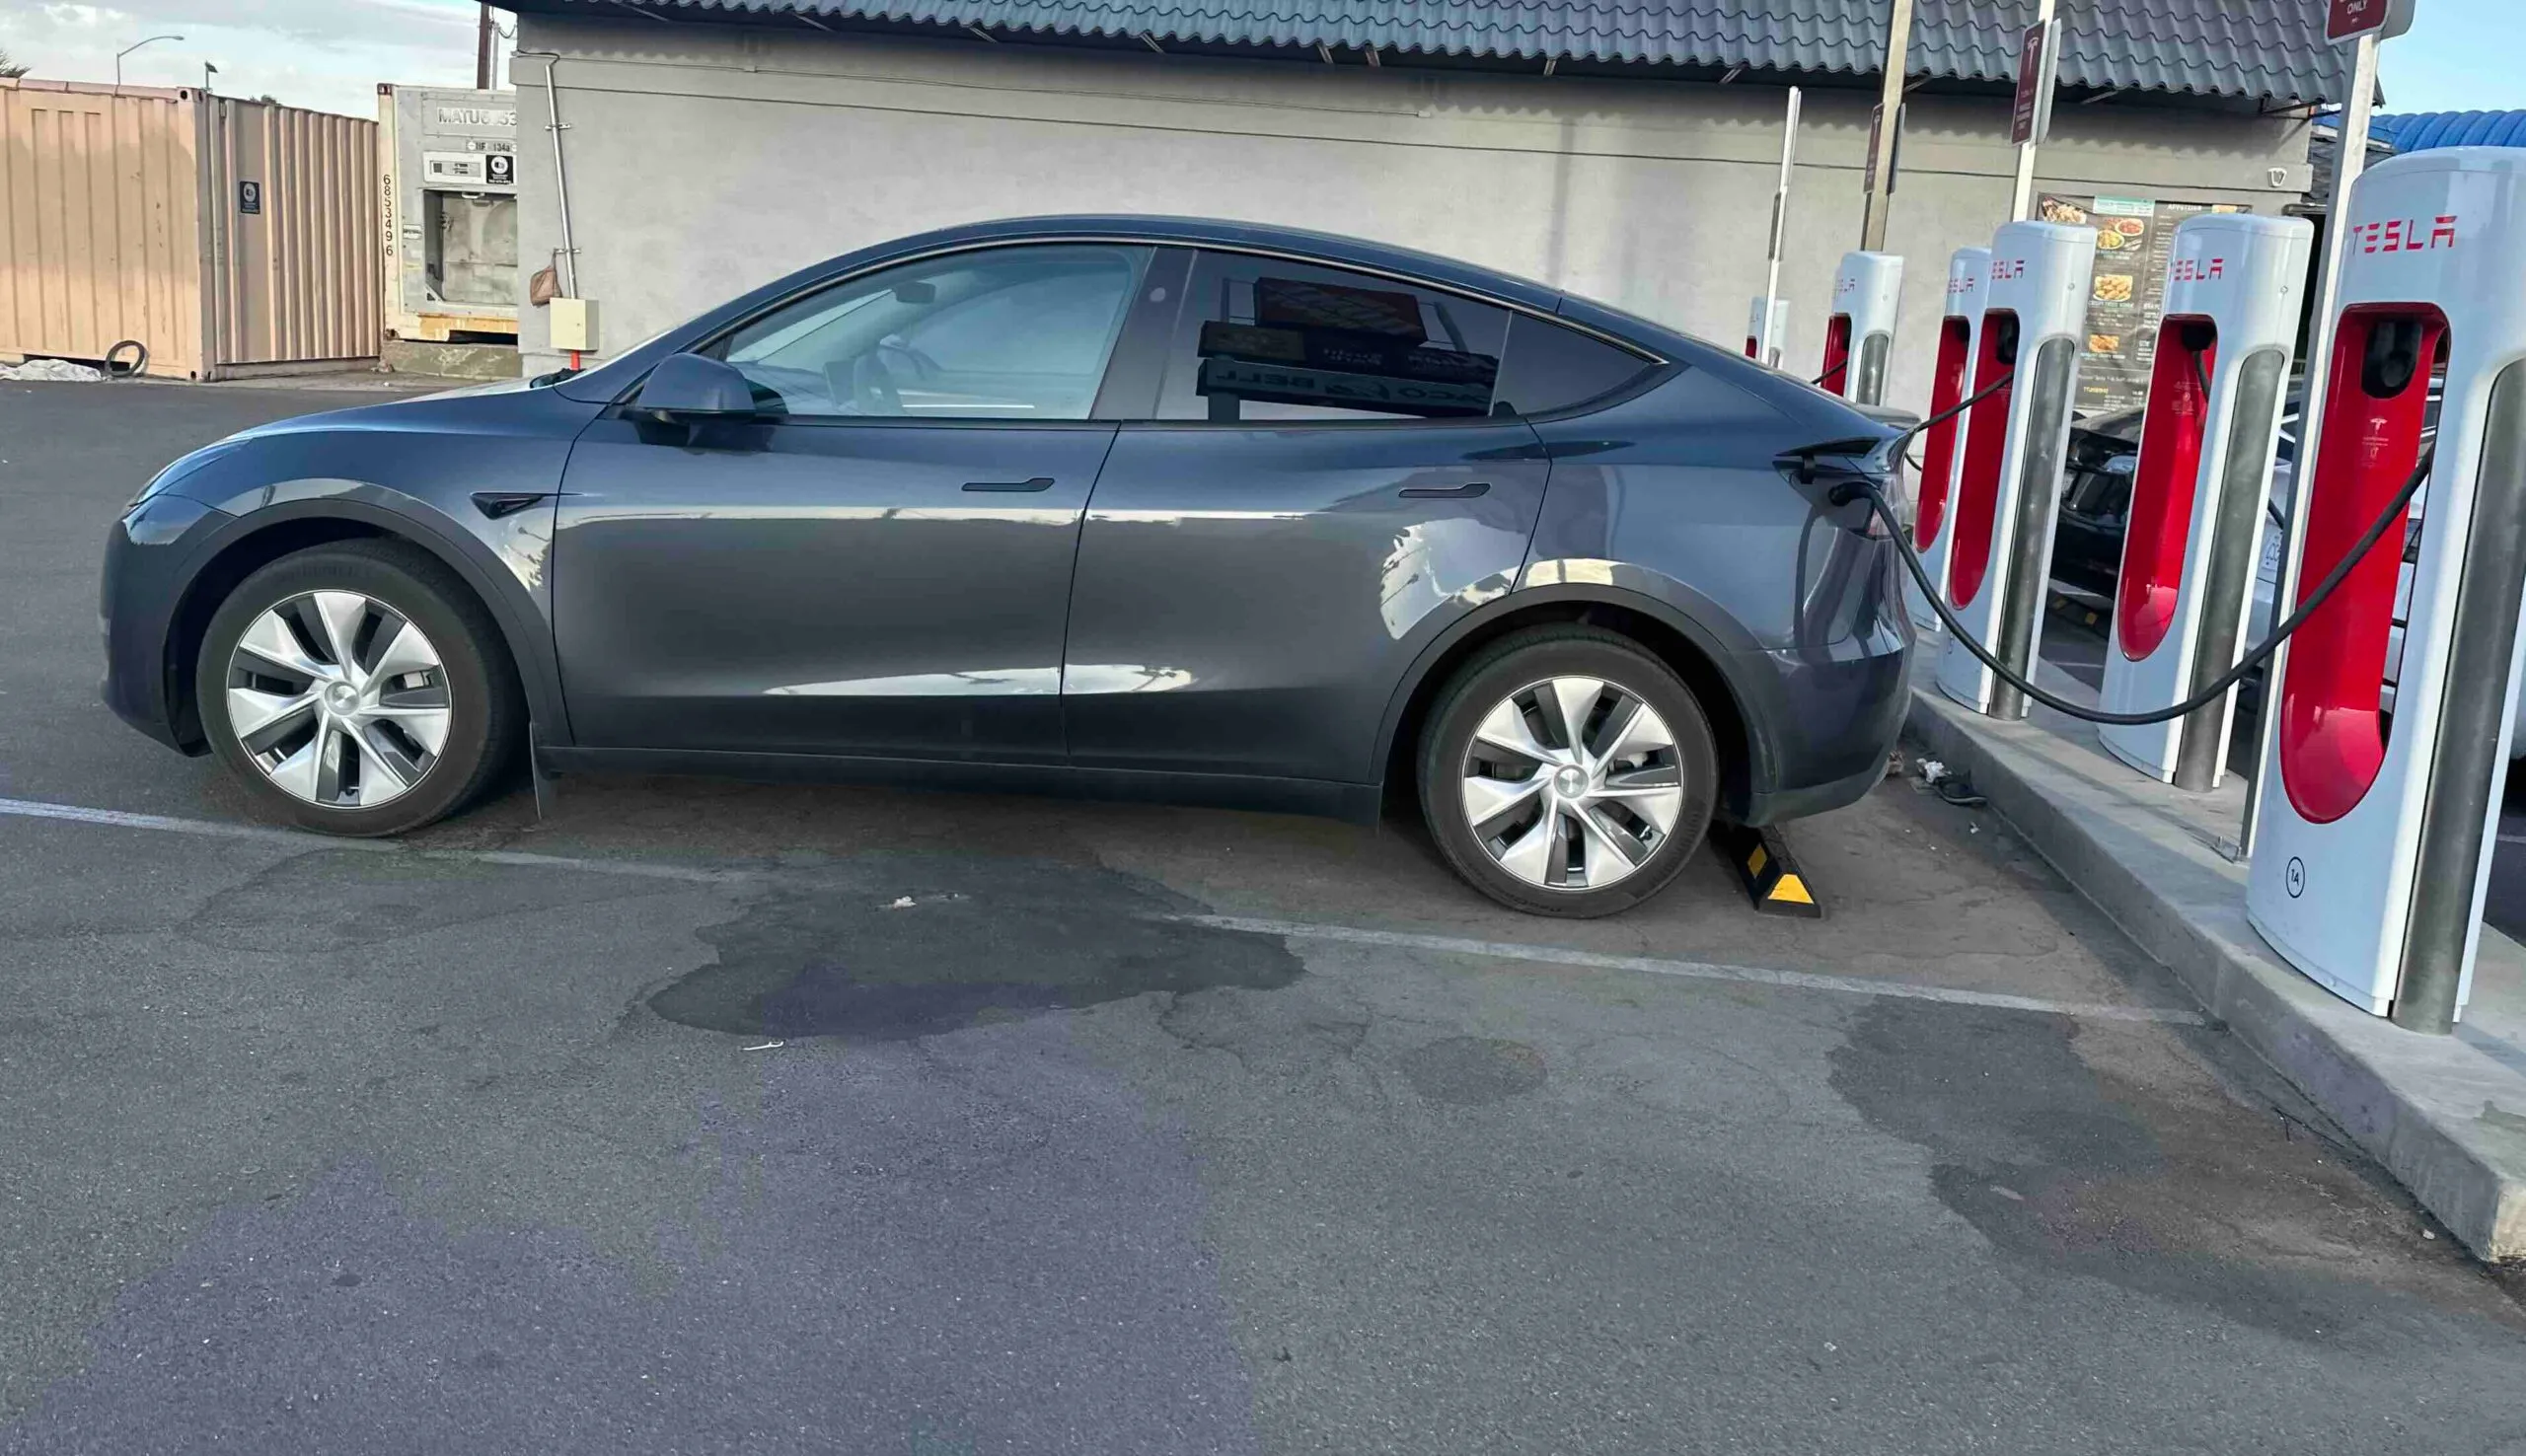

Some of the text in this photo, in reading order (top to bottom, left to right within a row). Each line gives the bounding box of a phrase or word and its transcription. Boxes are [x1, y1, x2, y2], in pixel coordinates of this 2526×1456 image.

[383, 174, 394, 256] 6853496
[2352, 215, 2458, 255] TESLA
[1991, 259, 2026, 279] ESLA
[1948, 277, 1974, 293] ESLA
[2290, 868, 2300, 887] 14
